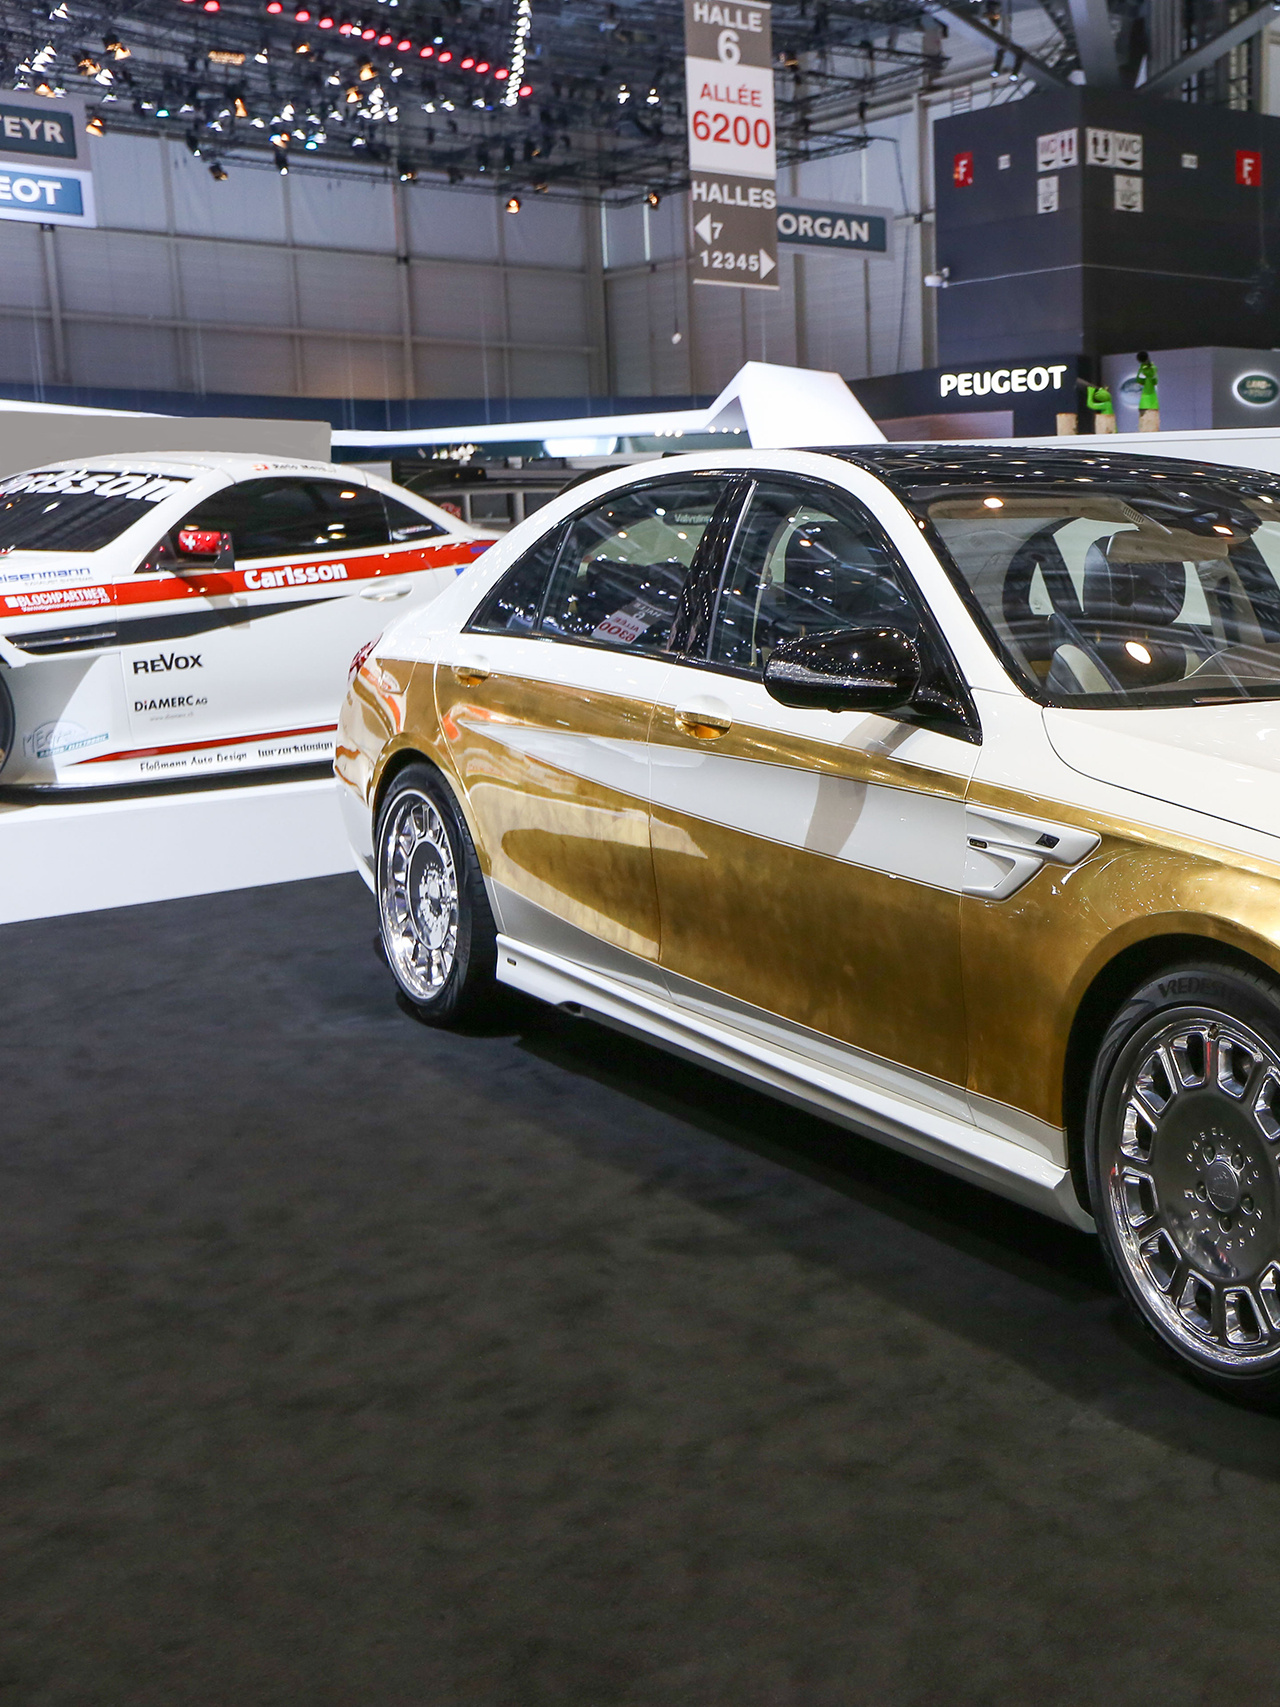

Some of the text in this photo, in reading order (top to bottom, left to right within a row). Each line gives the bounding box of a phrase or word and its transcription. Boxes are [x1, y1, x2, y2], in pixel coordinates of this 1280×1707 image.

[693, 3, 763, 33] HALLE
[717, 29, 742, 65] 6
[700, 82, 762, 107] ALLÉE
[0, 115, 64, 144] EYR
[693, 110, 771, 148] 6200
[1115, 136, 1141, 155] WC
[1242, 158, 1254, 179] F
[0, 175, 62, 206] EOT
[692, 180, 777, 209] HALLES
[711, 222, 724, 240] 7
[777, 213, 869, 243] ORGAN
[940, 364, 1067, 398] PEUGEOT
[244, 563, 348, 589] Carlsson
[191, 756, 213, 765] Auto
[216, 751, 247, 763] Design
